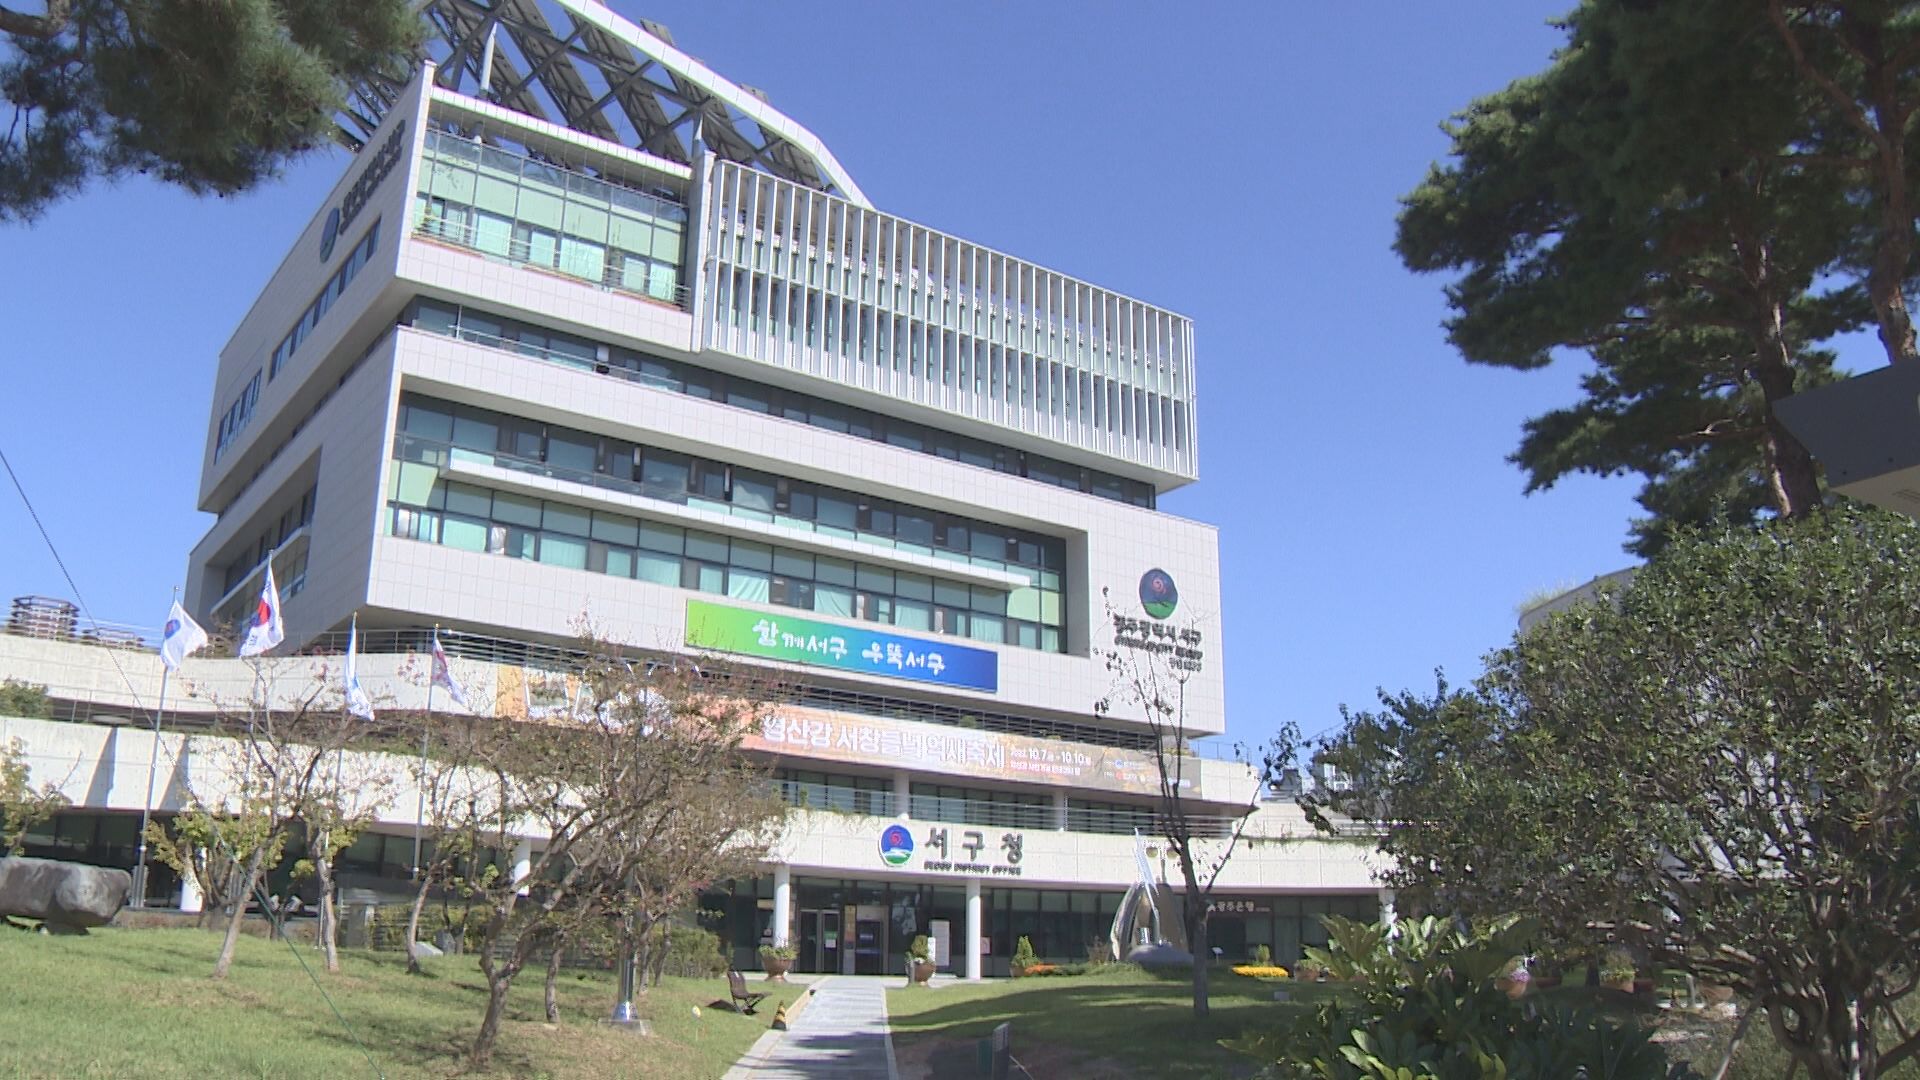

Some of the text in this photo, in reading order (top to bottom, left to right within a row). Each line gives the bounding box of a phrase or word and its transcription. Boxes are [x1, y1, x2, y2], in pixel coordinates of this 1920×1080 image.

[752, 618, 946, 676] 함께서구 우뚝서구
[924, 827, 1023, 864] 서구청
